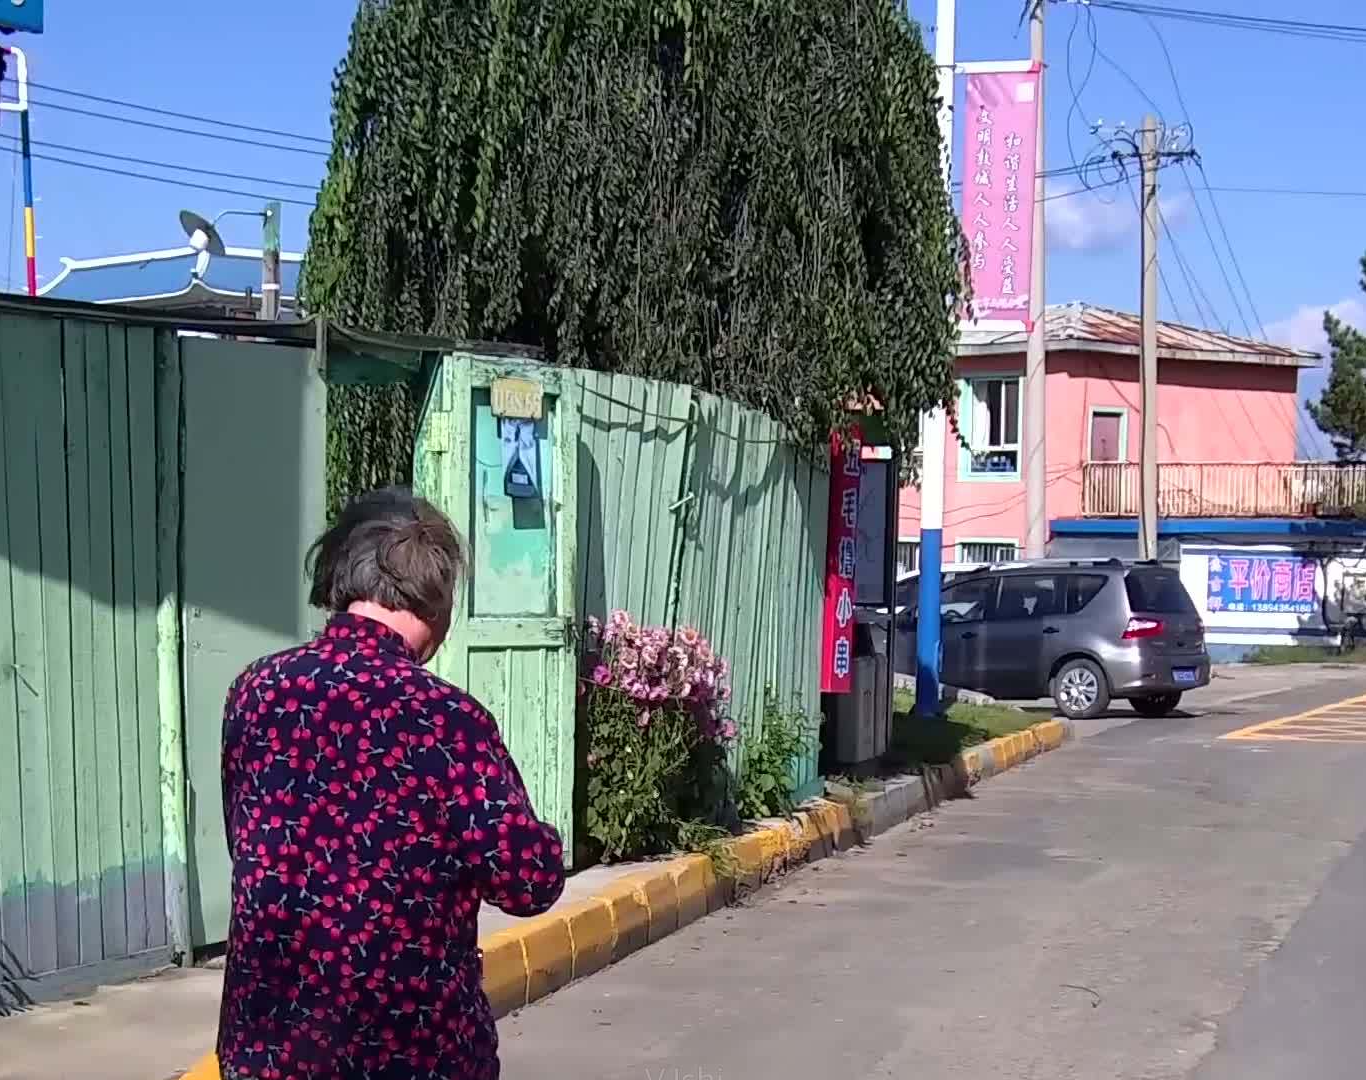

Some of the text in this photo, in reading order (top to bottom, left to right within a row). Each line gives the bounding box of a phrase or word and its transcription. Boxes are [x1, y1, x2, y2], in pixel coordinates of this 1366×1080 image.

[1001, 133, 1022, 294] 和谐生活人人受益
[1229, 559, 1315, 600] 平价商店
